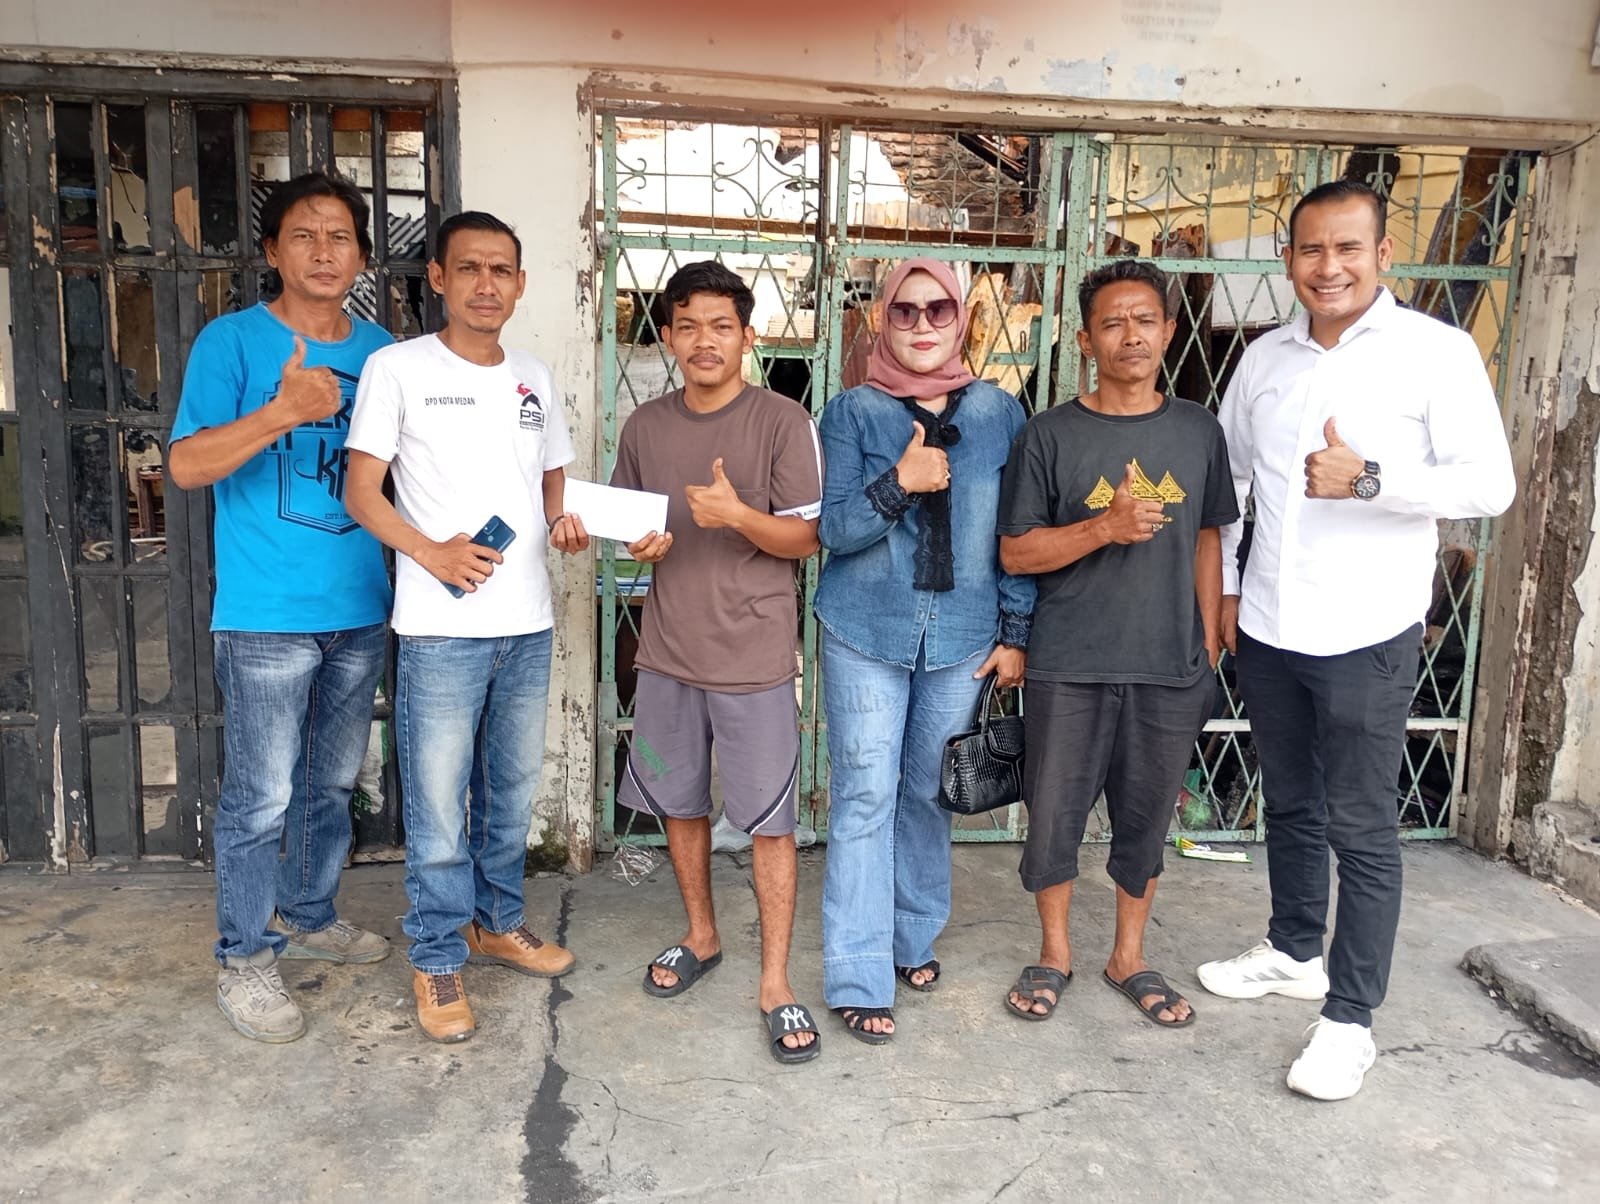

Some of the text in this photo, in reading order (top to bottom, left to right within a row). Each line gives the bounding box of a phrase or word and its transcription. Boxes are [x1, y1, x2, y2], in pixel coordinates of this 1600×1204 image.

[424, 396, 476, 406] DPD KOTA MEDAN
[519, 409, 545, 424] PSI
[779, 1006, 810, 1031] NY
